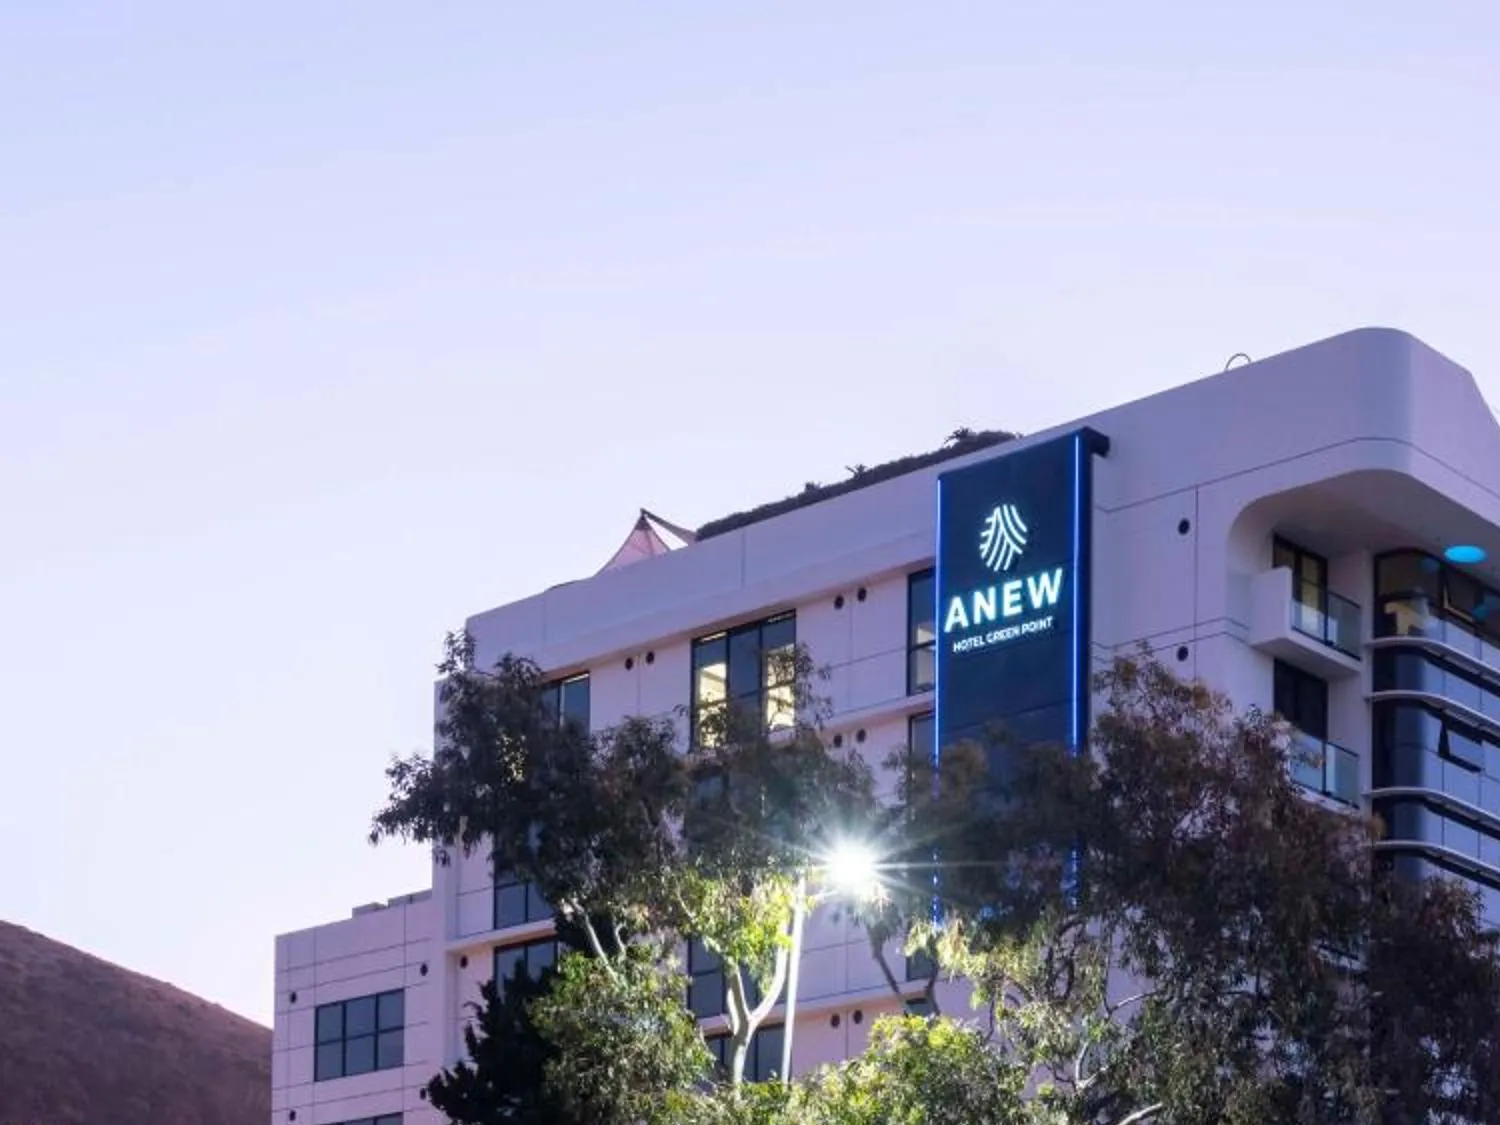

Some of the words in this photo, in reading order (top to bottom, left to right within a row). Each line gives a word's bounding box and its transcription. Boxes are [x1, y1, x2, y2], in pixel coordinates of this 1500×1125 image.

[944, 568, 1062, 633] ANEW
[953, 635, 985, 653] HOTEL
[986, 626, 1021, 643] GREEN
[1021, 616, 1053, 634] POINT
